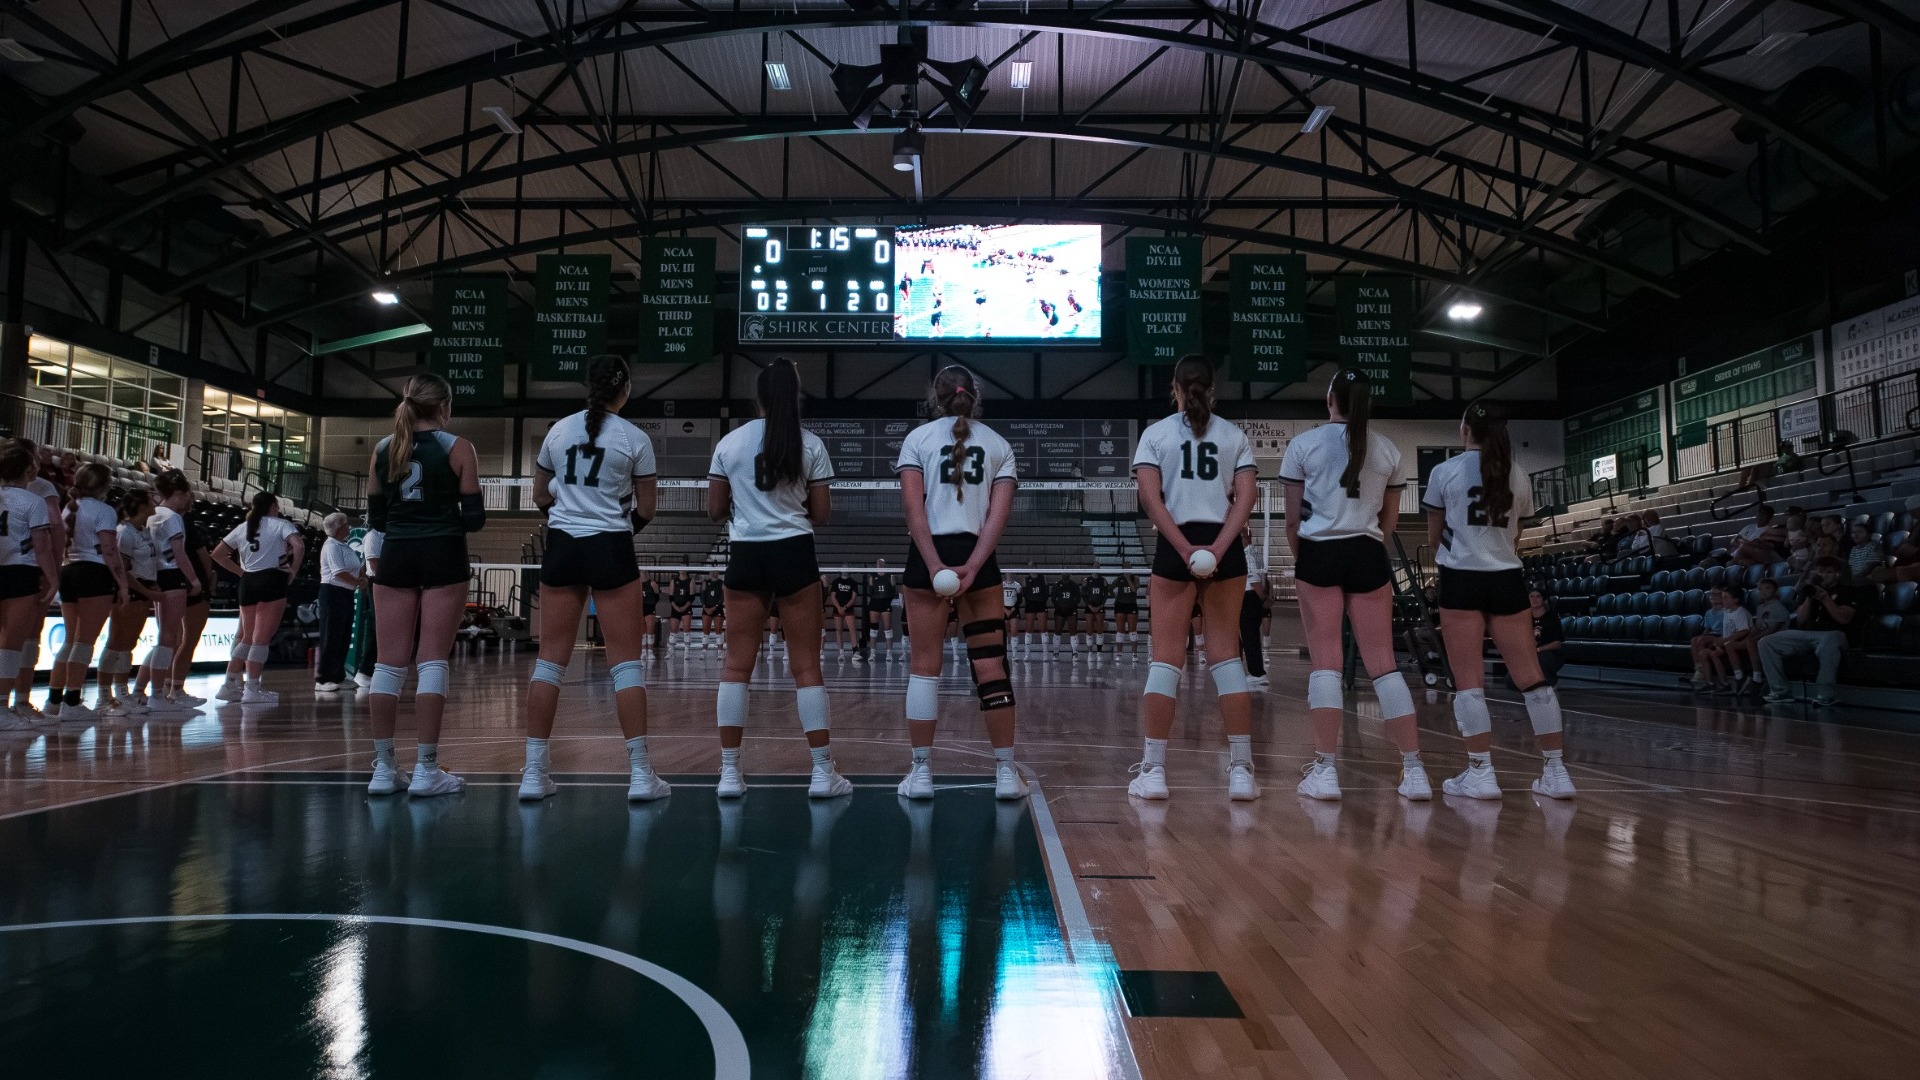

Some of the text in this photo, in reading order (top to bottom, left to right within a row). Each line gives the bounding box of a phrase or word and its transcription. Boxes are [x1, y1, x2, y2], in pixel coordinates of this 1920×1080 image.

[811, 227, 849, 250] 1:15
[664, 248, 693, 257] NCAA
[766, 240, 781, 263] 0
[874, 240, 890, 263] 0
[1149, 245, 1180, 255] NCAA
[1147, 256, 1181, 266] DIV. III
[560, 266, 589, 275] NCAA
[661, 264, 694, 273] DIV. III
[1254, 265, 1284, 275] NCAA
[556, 282, 589, 291] DIV. III
[661, 279, 693, 289] MEN'S
[1138, 279, 1190, 289] WOMEN'S
[1251, 281, 1285, 291] DIV. III
[455, 290, 484, 299] NCAA
[1129, 289, 1200, 299] BASKETBALL
[1359, 288, 1389, 298] NCAA
[556, 298, 588, 307] MEN'S
[644, 295, 711, 305] BASKETBALL
[820, 293, 826, 310] 1
[847, 292, 860, 310] 2
[876, 292, 888, 310] 0
[1252, 297, 1284, 307] MEN'S
[452, 306, 485, 315] DIV. III
[1357, 304, 1391, 314] DIV. III
[537, 313, 604, 323] BASKETBALL
[658, 311, 692, 321] THIRD
[1142, 313, 1187, 323] FOURTH
[1233, 313, 1303, 323] BASKETBALL
[453, 322, 484, 331] MEN'S
[769, 321, 890, 333] SHIRK CENTER
[1147, 324, 1183, 334] PLACE
[1357, 321, 1390, 330] MEN'S
[552, 330, 586, 339] THIRD
[659, 327, 693, 337] PLACE
[1253, 329, 1285, 339] FINAL
[433, 338, 502, 347] BASKETBALL
[1340, 337, 1409, 346] BASKETBALL
[553, 345, 586, 355] PLACE
[665, 343, 685, 353] 2006
[1155, 347, 1174, 357] 2011
[1254, 346, 1283, 355] FOUR
[449, 353, 482, 363] THIRD
[1358, 353, 1390, 363] FINAL
[559, 361, 578, 371] 2001
[1258, 362, 1278, 371] 2012
[449, 370, 483, 379] PLACE
[1714, 371, 1732, 382] ORDER
[1732, 367, 1740, 376] OF
[457, 386, 475, 395] 1996
[1370, 386, 1385, 395] 014
[940, 445, 985, 485] 23
[1180, 440, 1218, 480] 16
[564, 445, 605, 487] 17
[400, 459, 424, 501] 2
